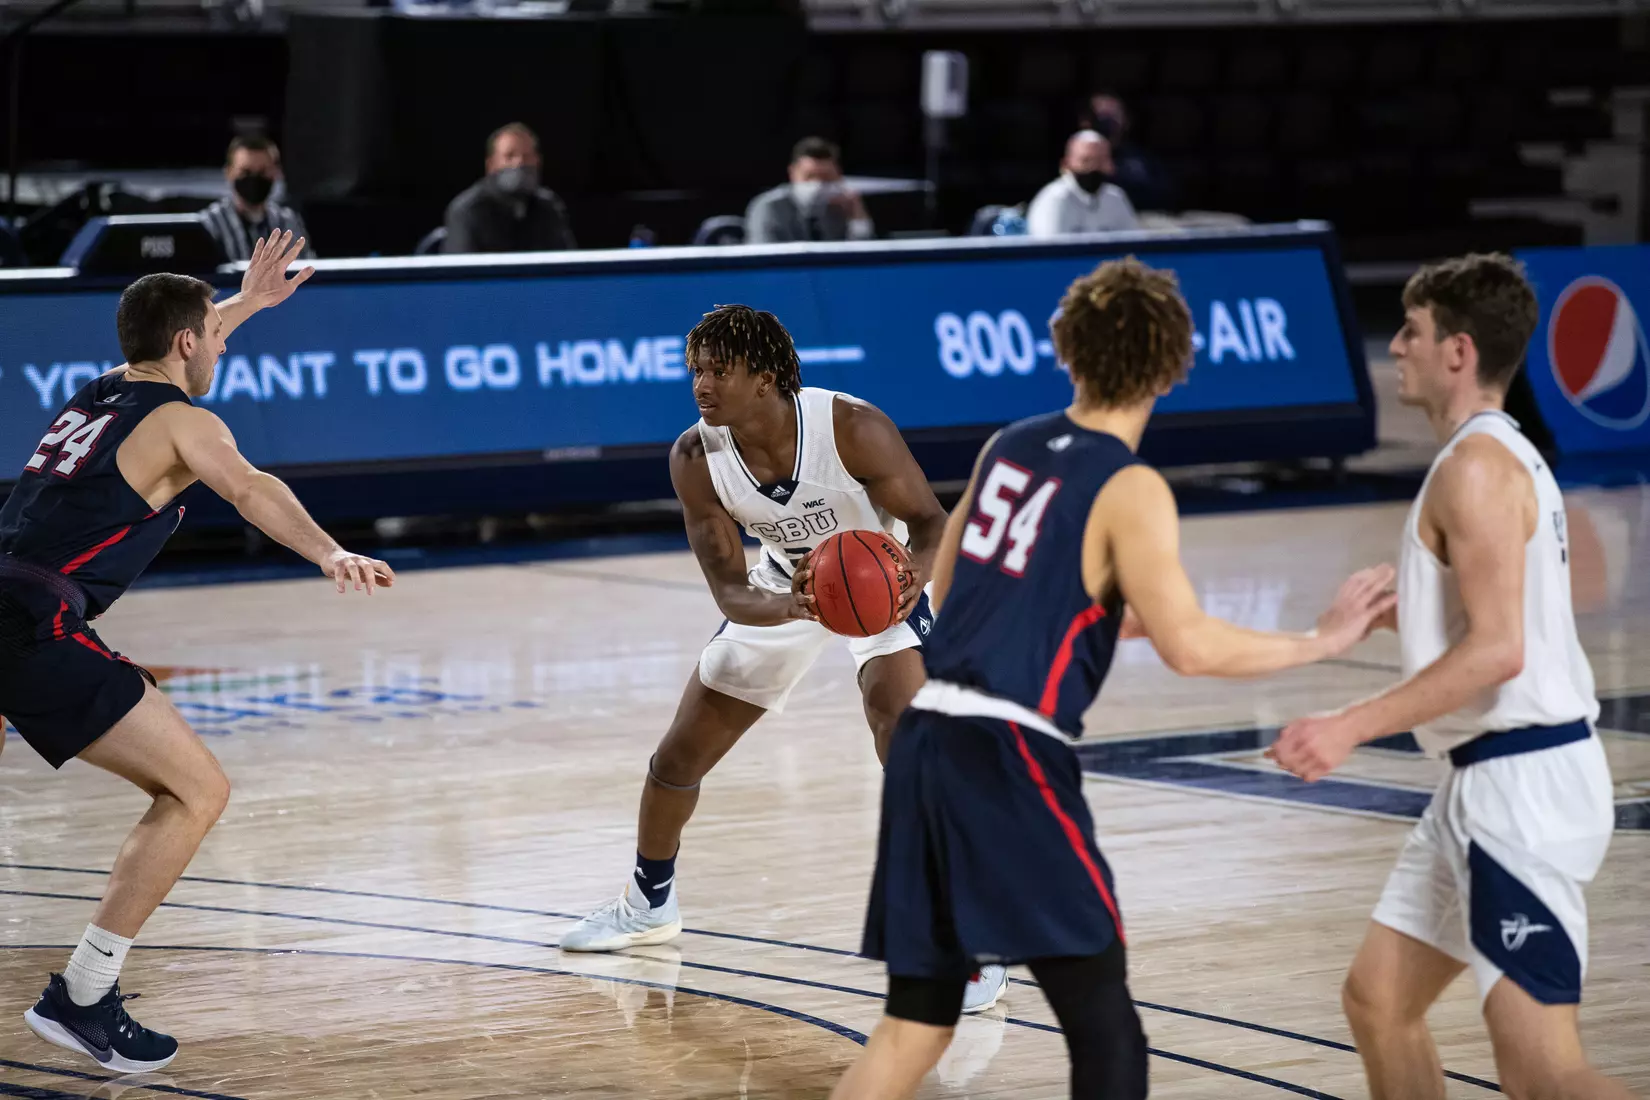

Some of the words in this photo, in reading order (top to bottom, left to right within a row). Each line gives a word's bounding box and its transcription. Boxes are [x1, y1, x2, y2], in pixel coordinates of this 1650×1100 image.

[23, 361, 112, 408] YO
[203, 352, 335, 401] ANT
[353, 348, 427, 394] TO
[444, 344, 521, 390] GO
[536, 336, 688, 386] HOME
[24, 407, 118, 479] 24
[749, 508, 839, 543] CBU
[802, 498, 826, 509] WAC
[959, 456, 1063, 578] 54
